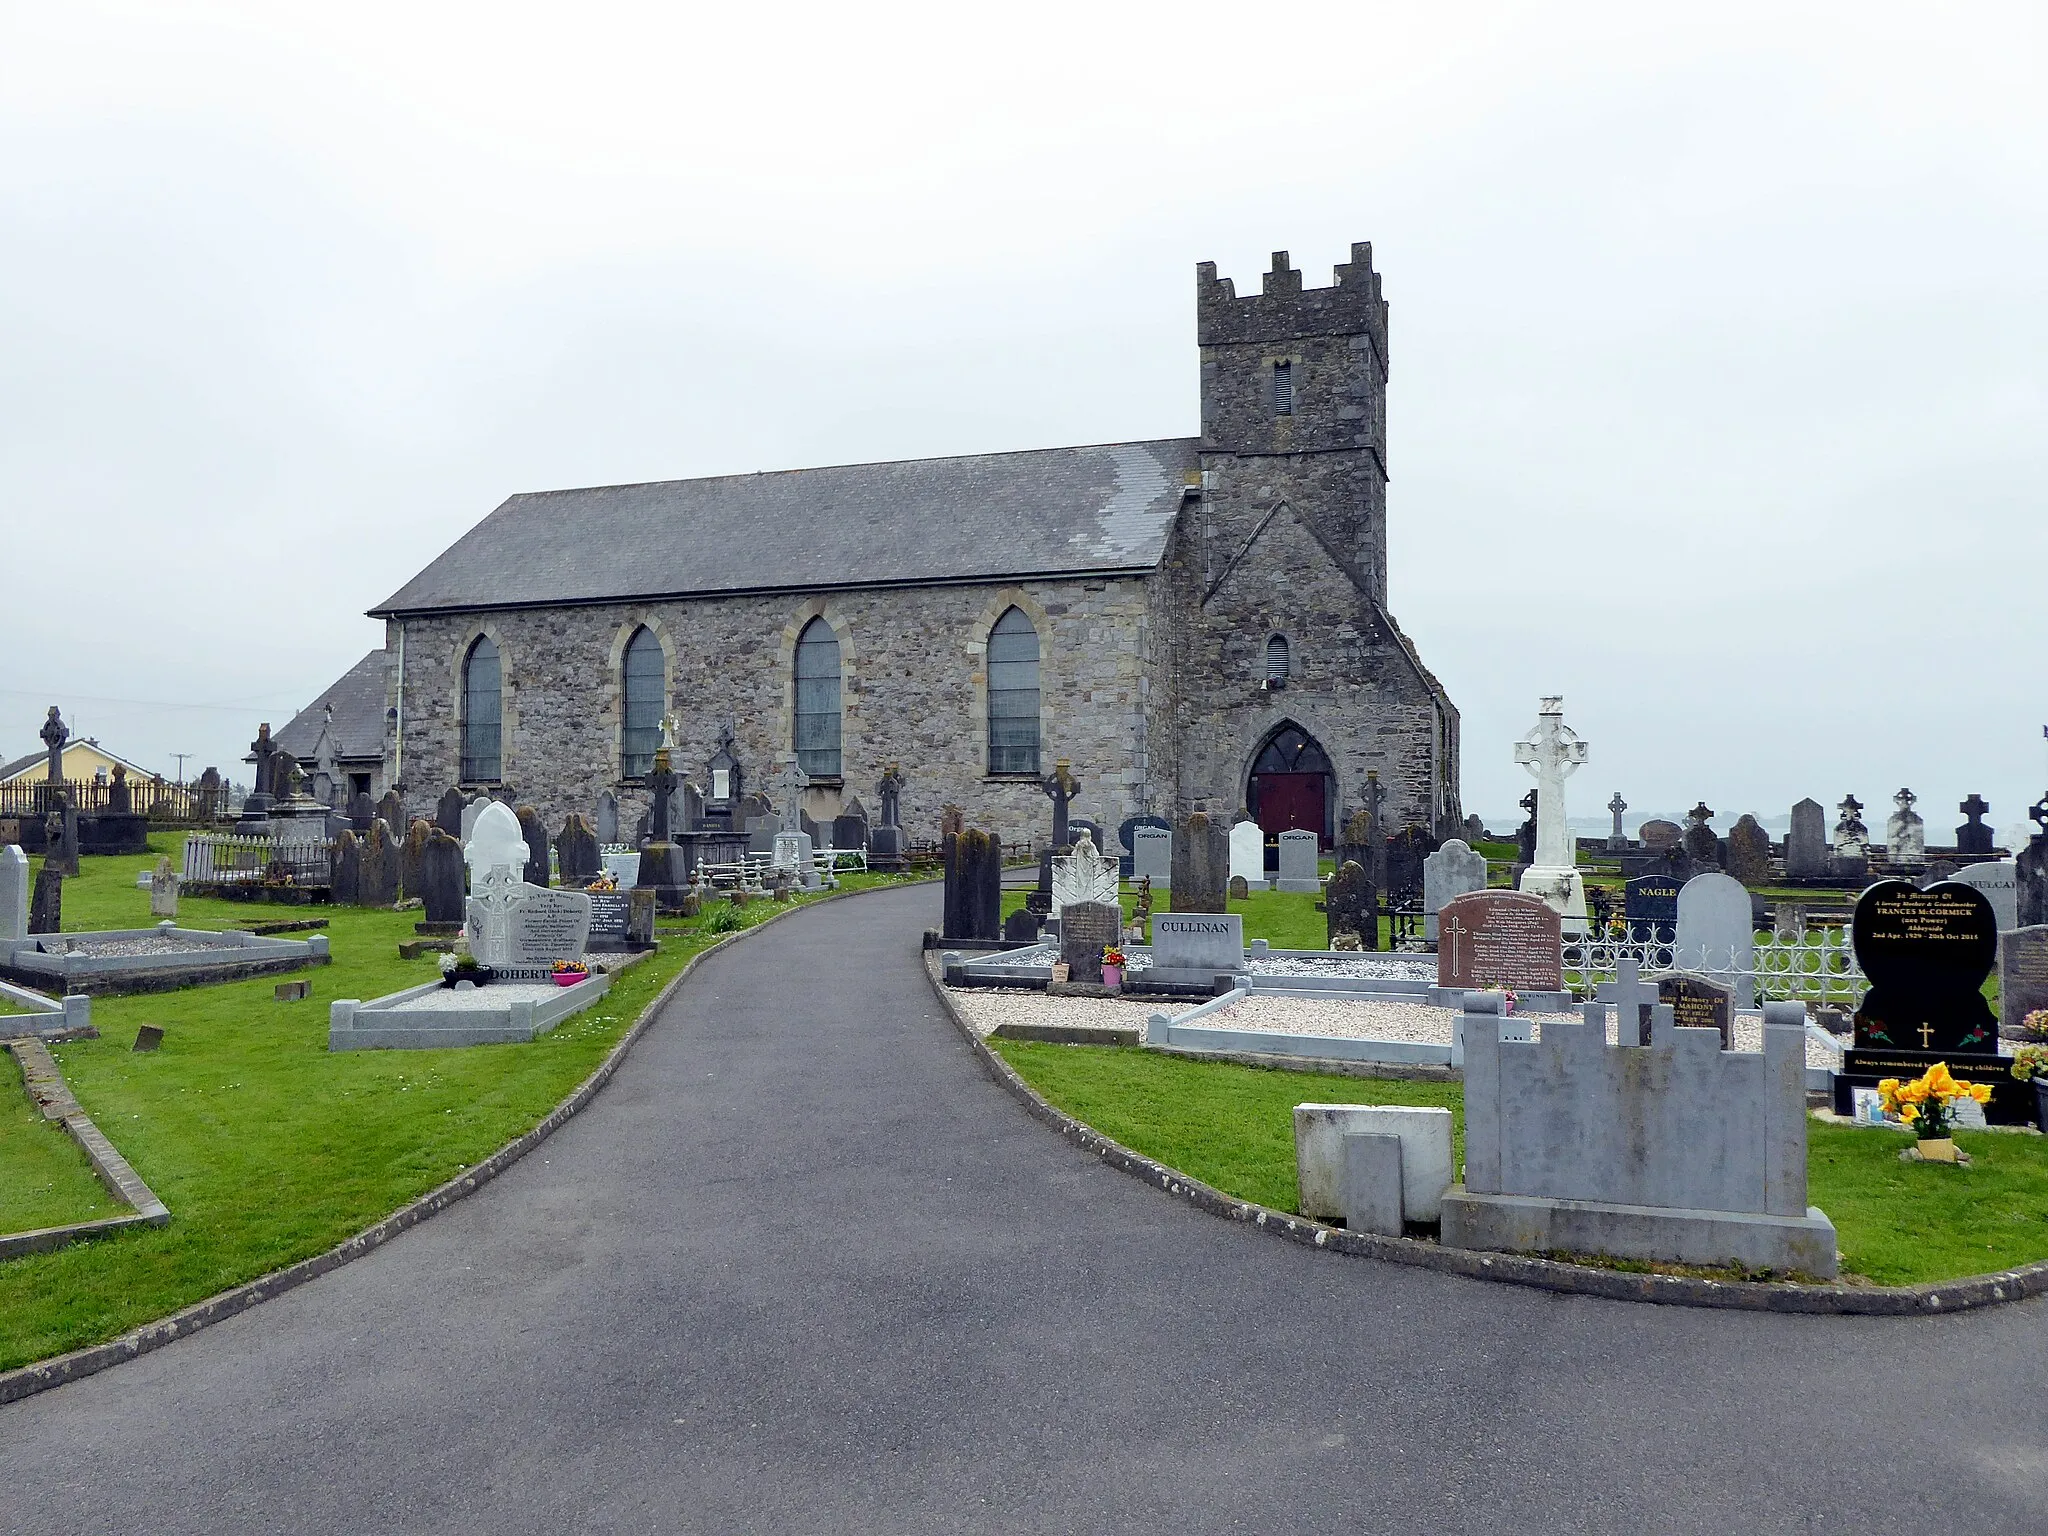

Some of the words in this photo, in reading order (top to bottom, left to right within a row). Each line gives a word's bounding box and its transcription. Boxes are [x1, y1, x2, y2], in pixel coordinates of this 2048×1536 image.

[1638, 888, 1677, 897] NAGLE
[1908, 892, 1939, 900] Memory
[1918, 908, 1973, 916] McCORMICK
[1920, 917, 1948, 925] Power)
[1161, 922, 1229, 933] CULLINAN
[1906, 924, 1943, 932] Abbeyside
[1679, 1003, 1714, 1011] MAHONY
[1854, 1058, 1879, 1067] Always
[1879, 1060, 1924, 1068] remembered
[1952, 1063, 1974, 1072] loving
[1975, 1064, 2005, 1072] children
